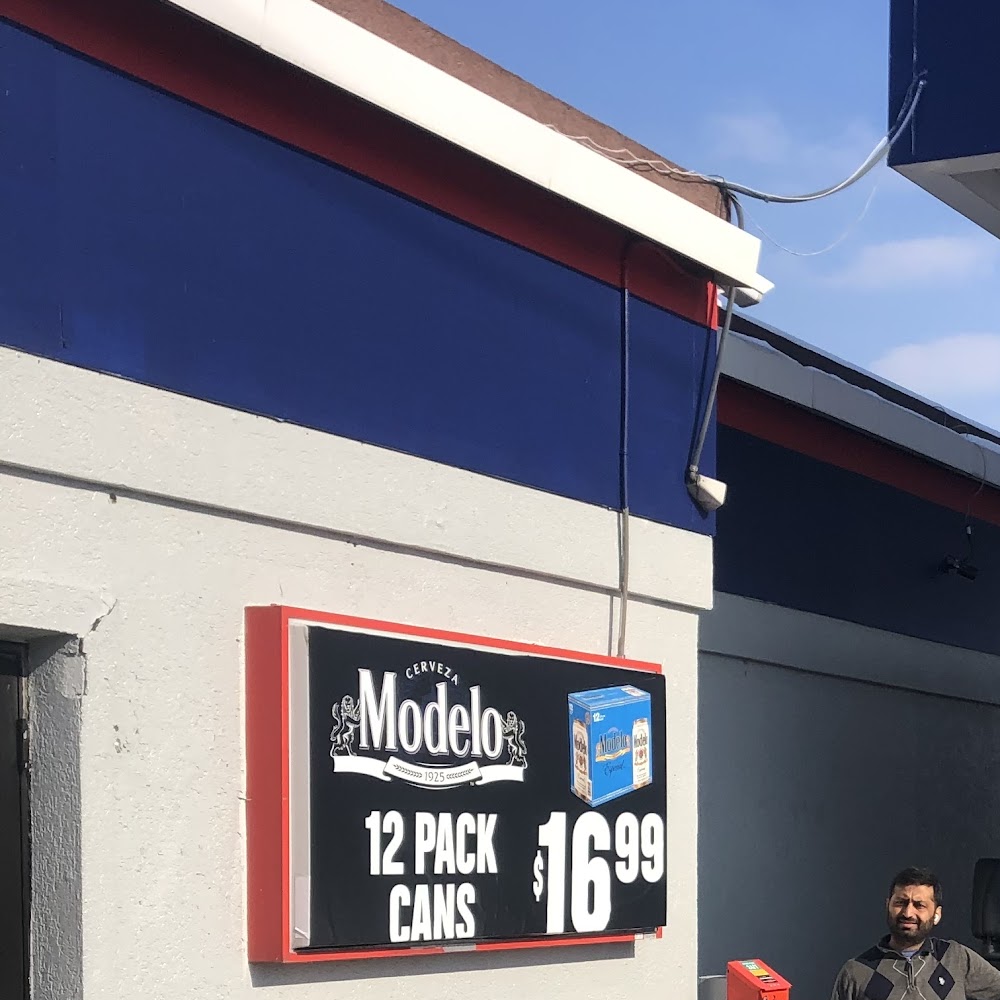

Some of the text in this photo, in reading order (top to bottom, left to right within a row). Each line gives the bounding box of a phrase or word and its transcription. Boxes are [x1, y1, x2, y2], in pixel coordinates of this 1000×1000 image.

[405, 660, 459, 686] CERVEZA
[357, 667, 505, 760] Modelo
[424, 771, 446, 783] 1925
[365, 810, 499, 876] 12 PACK
[389, 882, 476, 943] CANS
